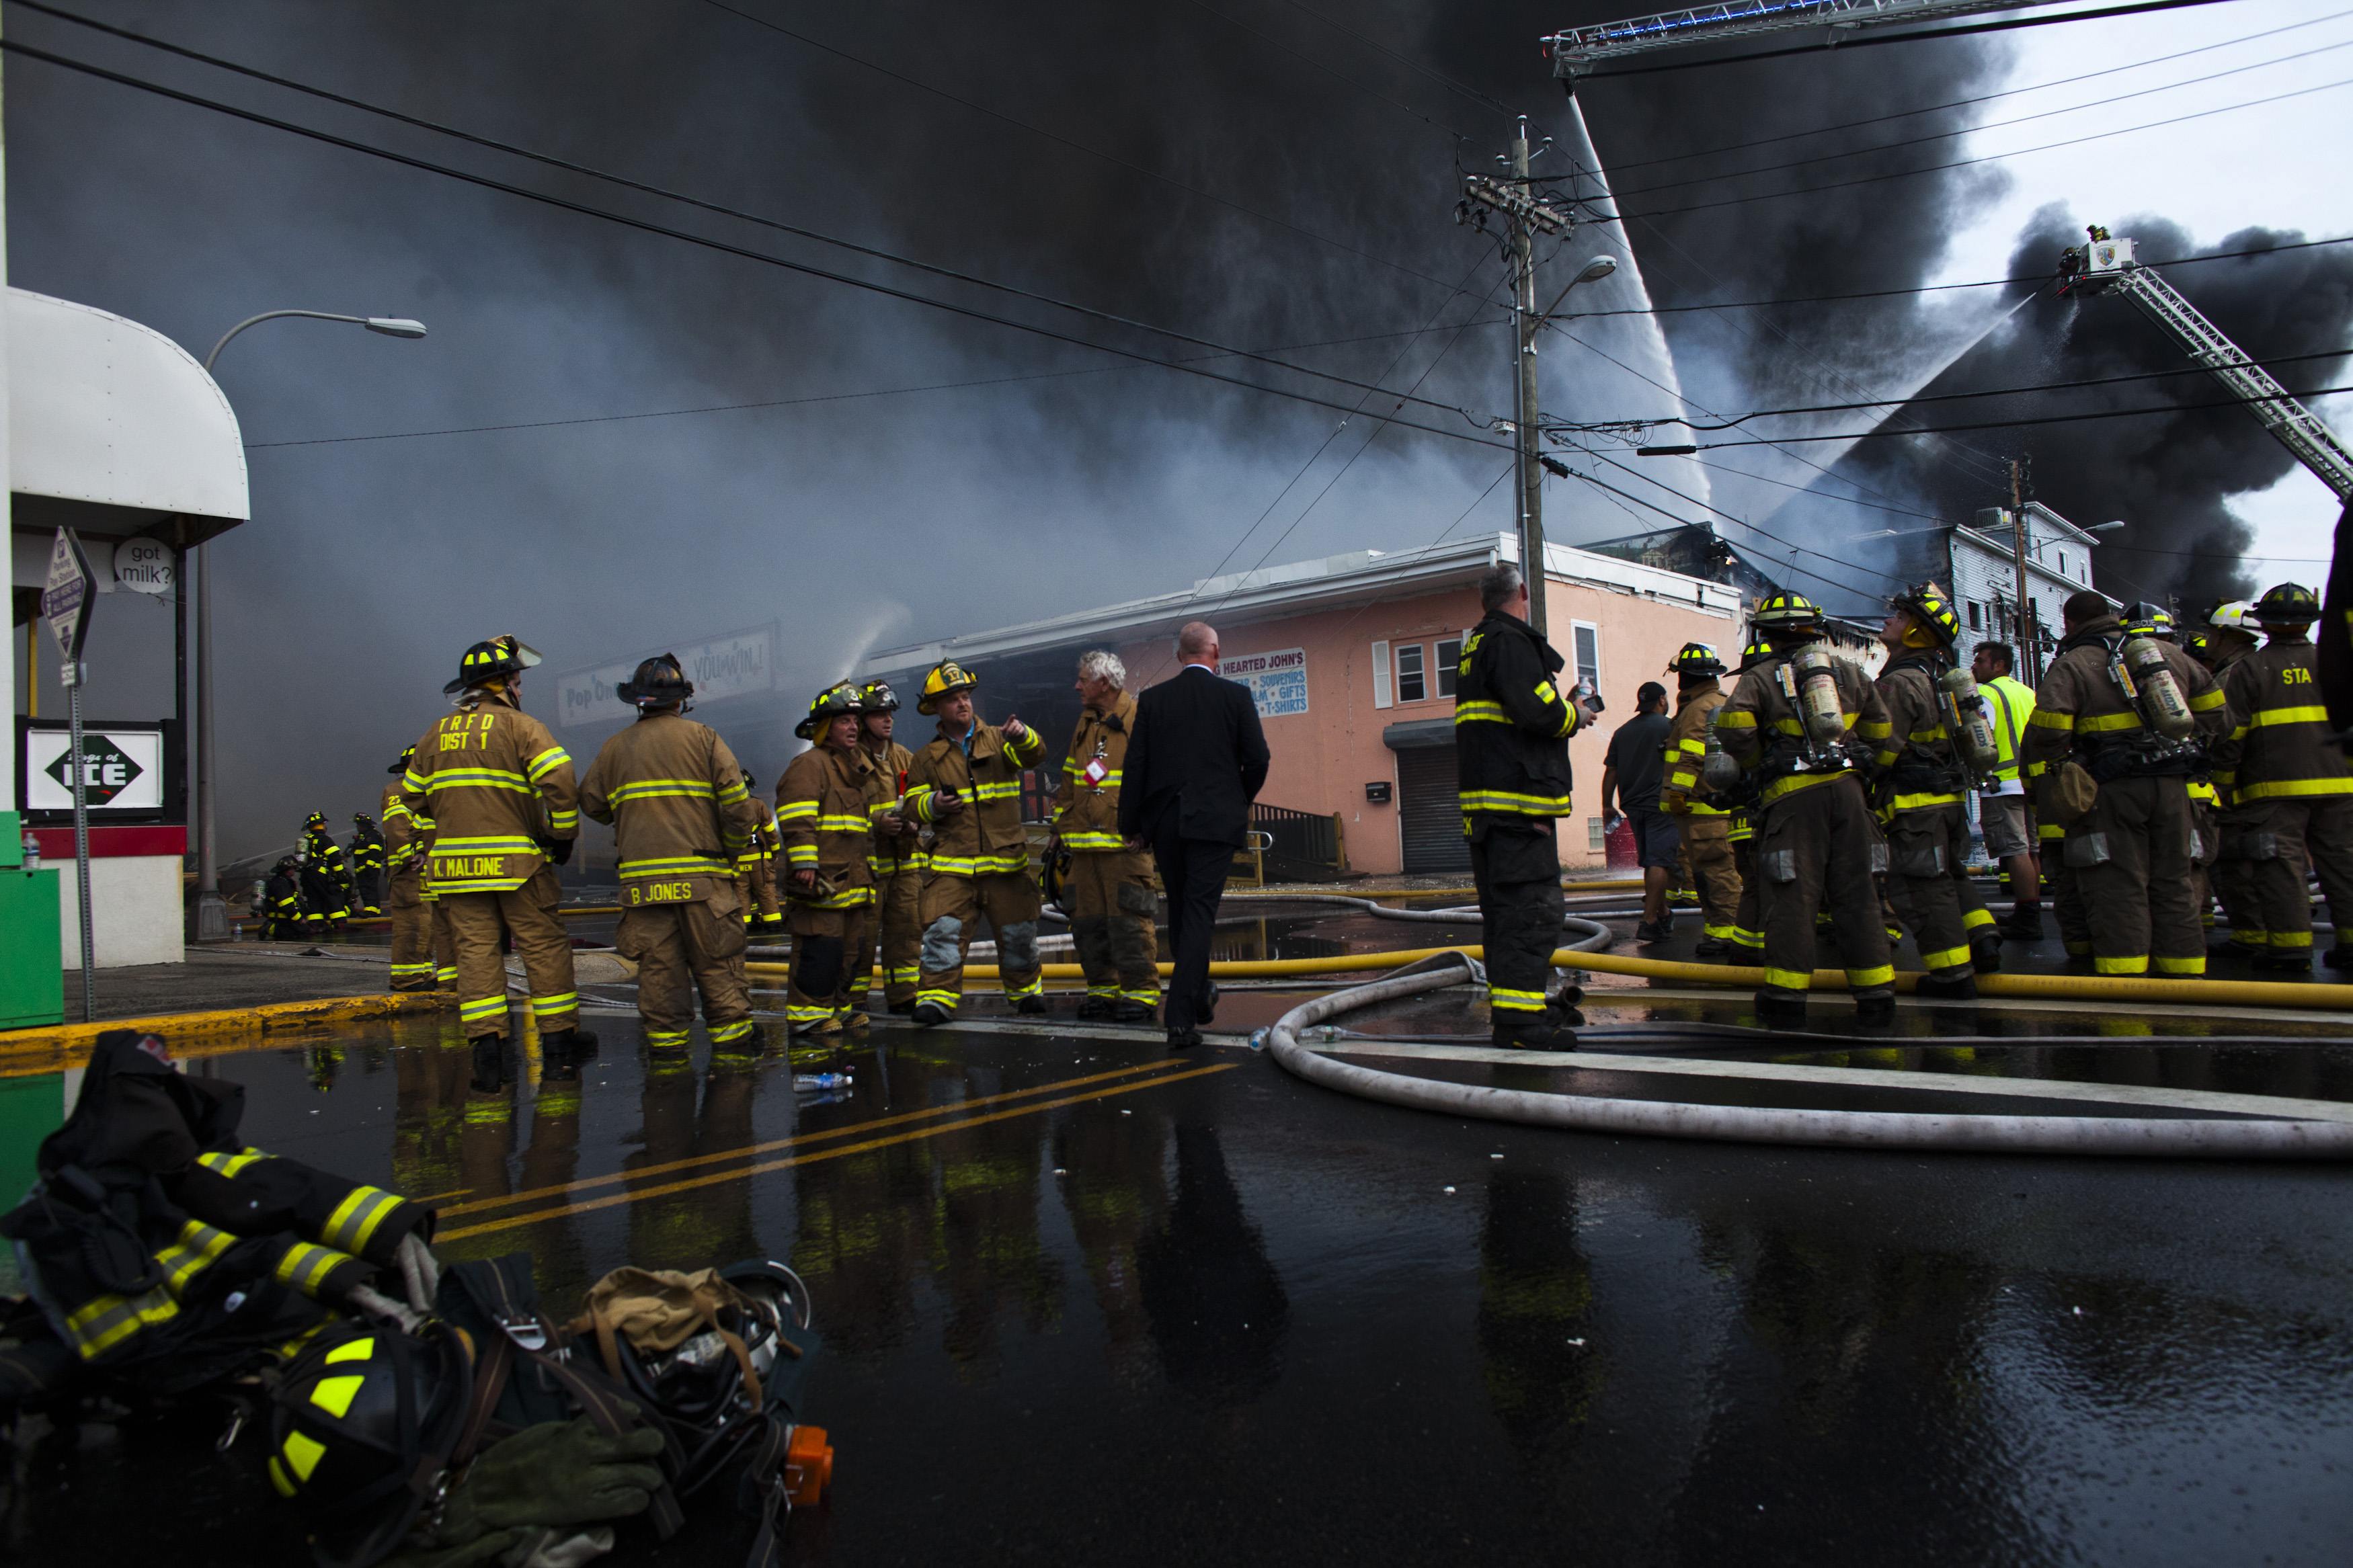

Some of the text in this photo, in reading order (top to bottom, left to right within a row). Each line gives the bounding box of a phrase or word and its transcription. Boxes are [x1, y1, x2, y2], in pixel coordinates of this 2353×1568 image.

[132, 547, 161, 562] got
[123, 565, 172, 584] milk?
[2128, 619, 2156, 629] RESCUE
[1224, 657, 1266, 675] HEARTED
[1269, 652, 1304, 668] JOHN'S
[1259, 671, 1305, 688] SOUVENIRS
[2282, 667, 2312, 685] STA
[848, 689, 859, 701] 3
[1251, 685, 1306, 702] ILM GIFTS
[1265, 698, 1306, 714] T-SHIRTS
[440, 731, 488, 751] DIST 1
[1972, 724, 1987, 747] SCOTT
[106, 753, 120, 762] of
[446, 857, 504, 876] MALONE
[645, 882, 692, 902] JONES
